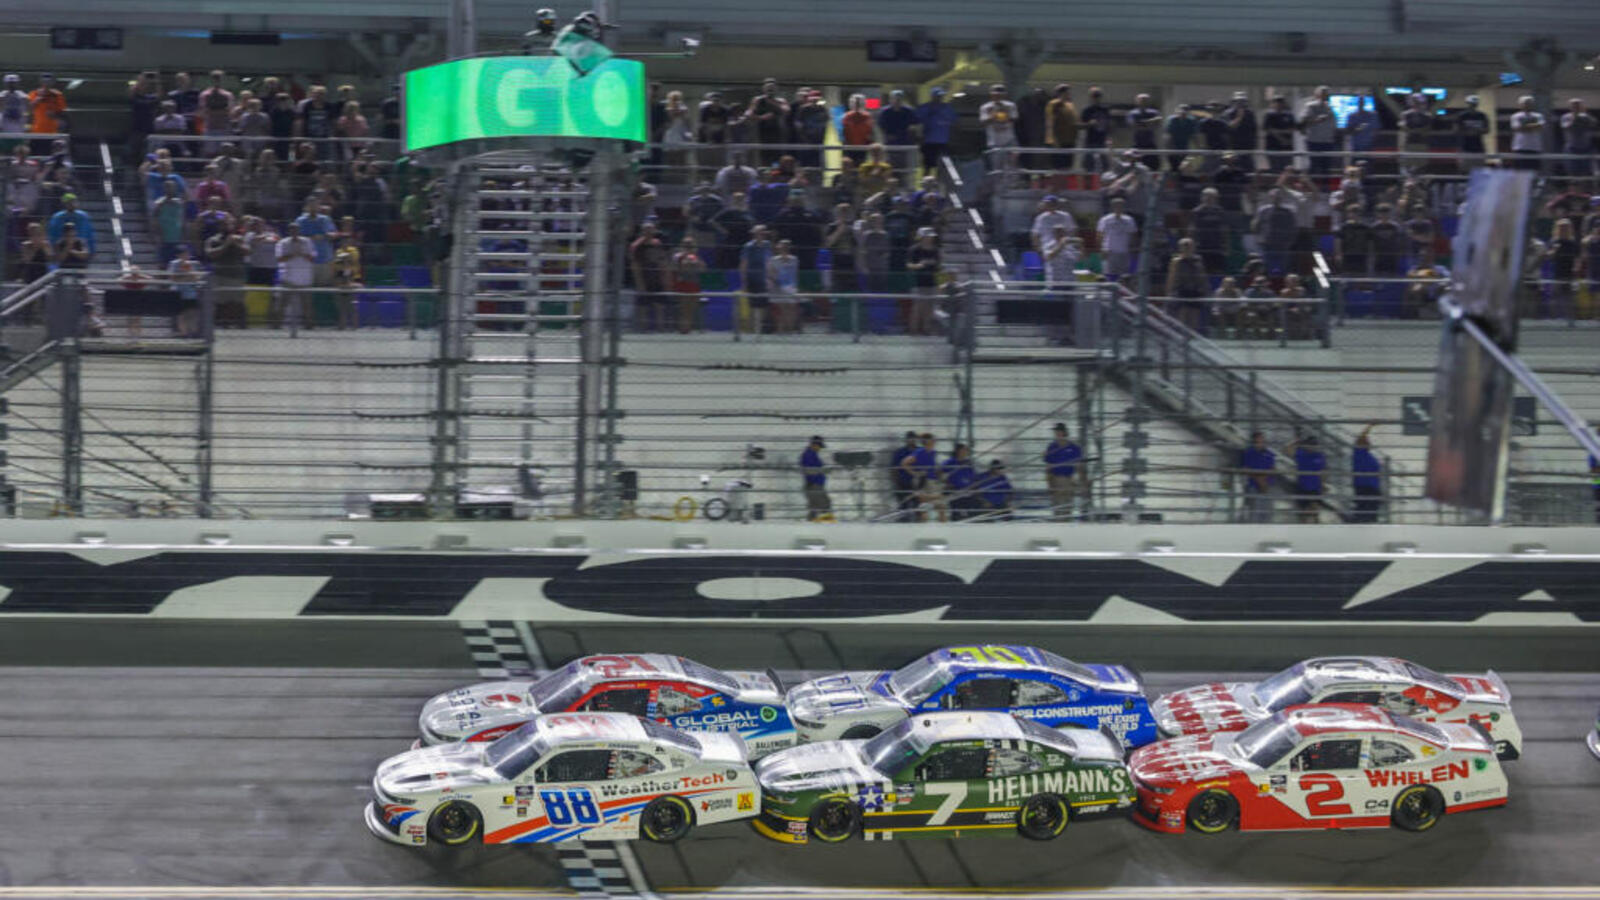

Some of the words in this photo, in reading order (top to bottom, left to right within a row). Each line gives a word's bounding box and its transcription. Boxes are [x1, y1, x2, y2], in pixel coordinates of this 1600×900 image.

[675, 710, 759, 727] GLOBAL
[1036, 704, 1123, 718] CONSTRUCTION
[601, 772, 724, 796] WeatherTech
[1364, 760, 1469, 788] WHELEN
[539, 787, 601, 826] 88
[924, 782, 968, 826] 7
[1299, 773, 1353, 816] 2
[1364, 800, 1389, 809] C4
